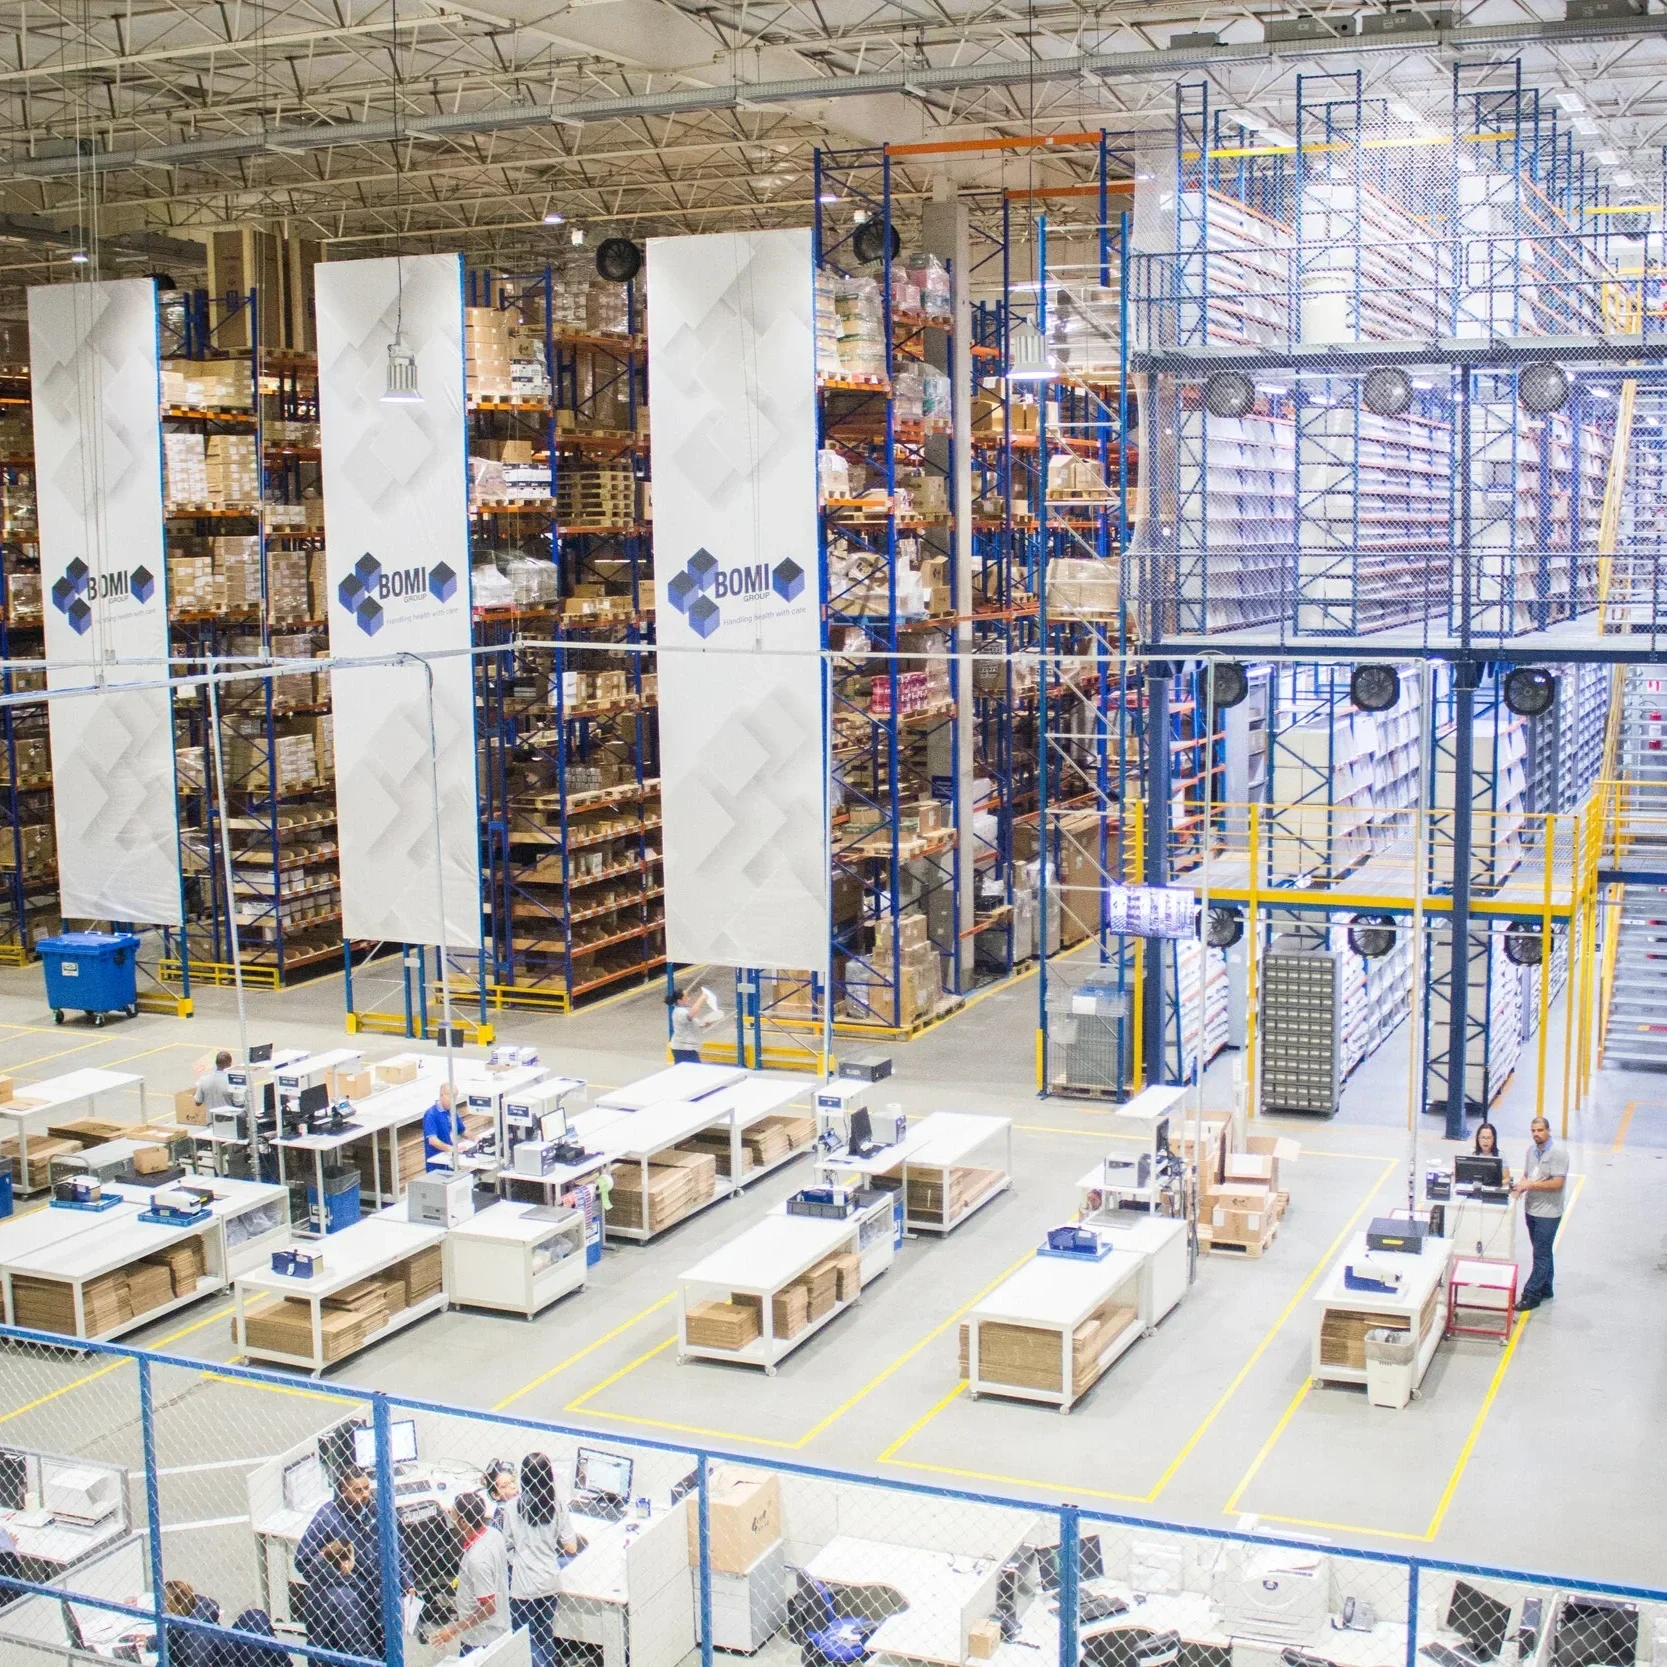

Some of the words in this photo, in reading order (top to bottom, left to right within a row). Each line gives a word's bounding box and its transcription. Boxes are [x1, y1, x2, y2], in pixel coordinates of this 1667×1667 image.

[87, 570, 129, 601] BOMI
[379, 566, 427, 600] BOMI
[714, 563, 770, 599] BOMI
[403, 593, 428, 604] GROUP
[743, 592, 771, 603] GROUP
[412, 611, 431, 621] health
[723, 615, 753, 626] Handling
[753, 611, 775, 622] health
[775, 609, 791, 618] with
[791, 606, 807, 615] care
